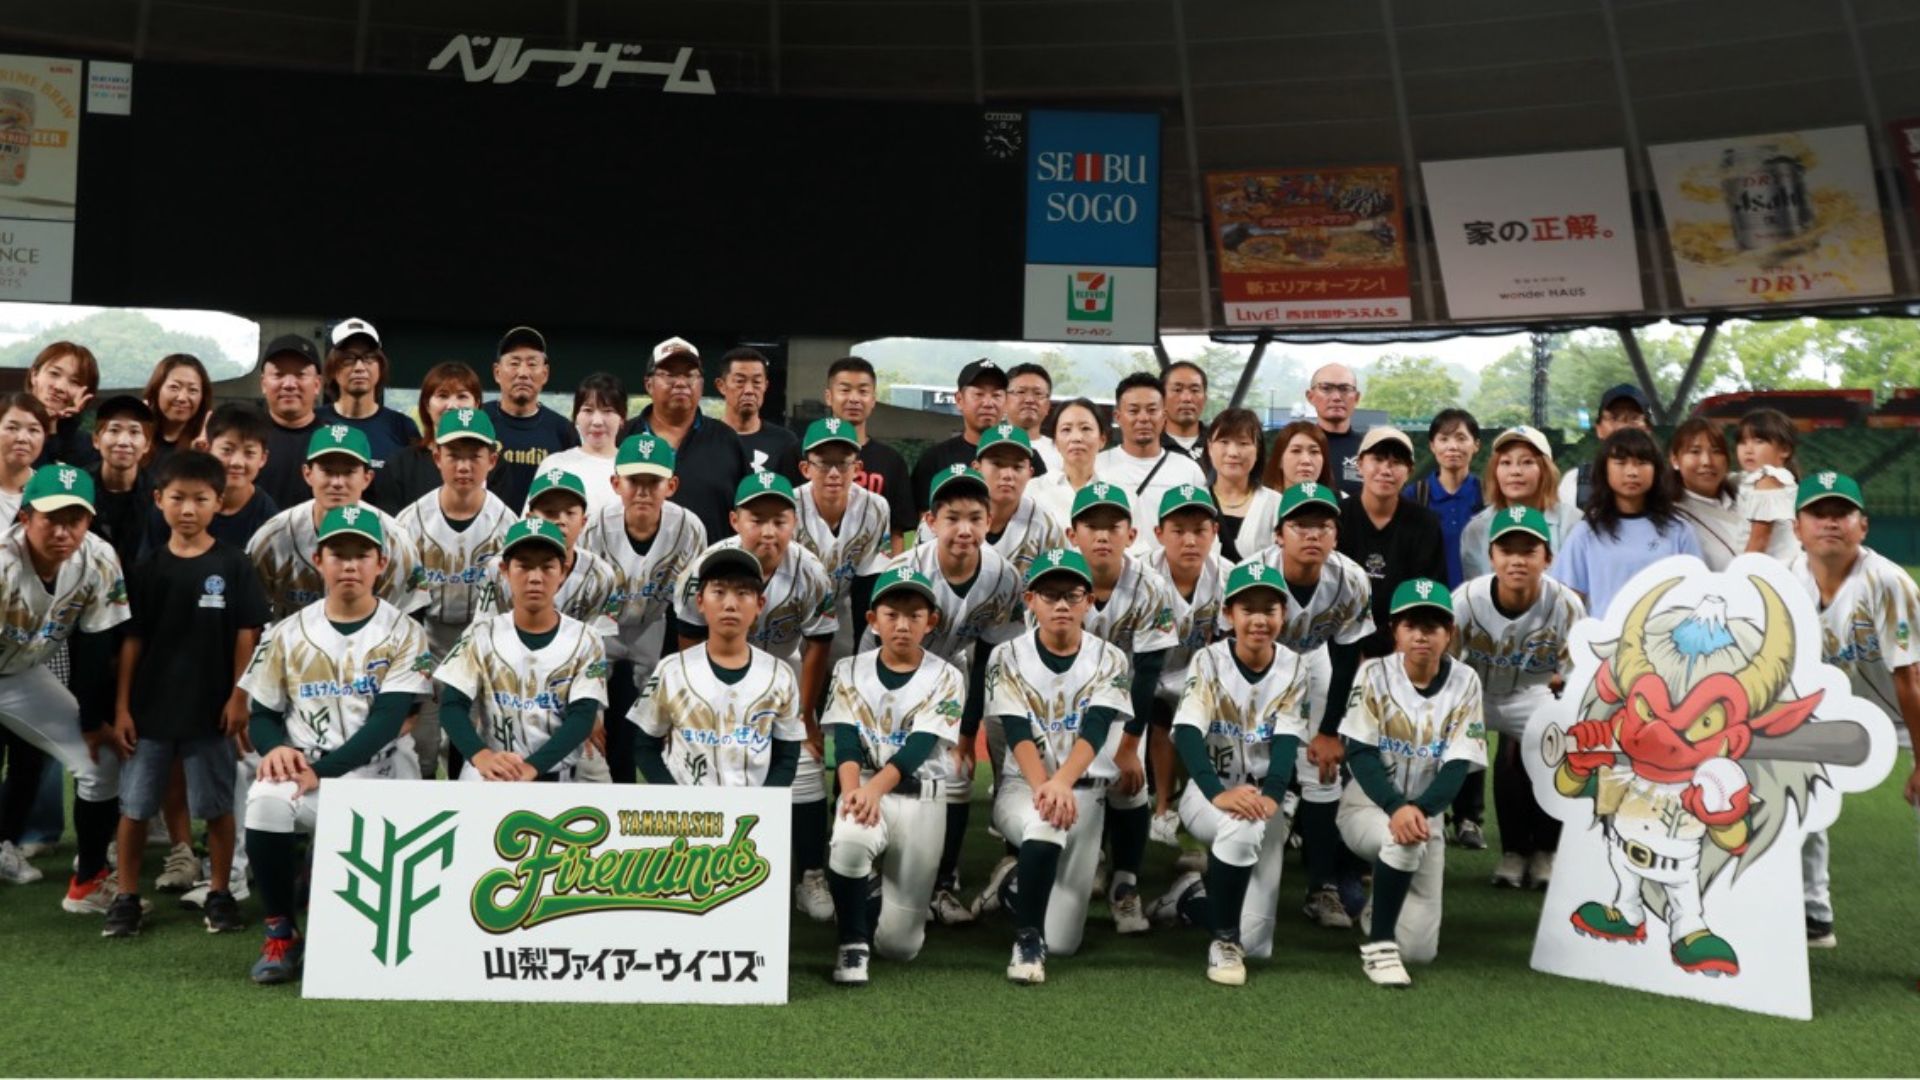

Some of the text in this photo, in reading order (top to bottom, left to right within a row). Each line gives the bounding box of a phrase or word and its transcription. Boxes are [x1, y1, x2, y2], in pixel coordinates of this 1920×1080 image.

[1037, 152, 1148, 184] SEIBU
[1047, 193, 1137, 224] SOGO
[1463, 214, 1614, 246] 家の正解。
[1549, 286, 1587, 297] HAUS
[680, 725, 773, 748] ほけんのぜん
[618, 810, 724, 836] YAMANASHI
[470, 806, 770, 935] Firewinds
[483, 946, 766, 983] 山梨ファイアーウインズ
